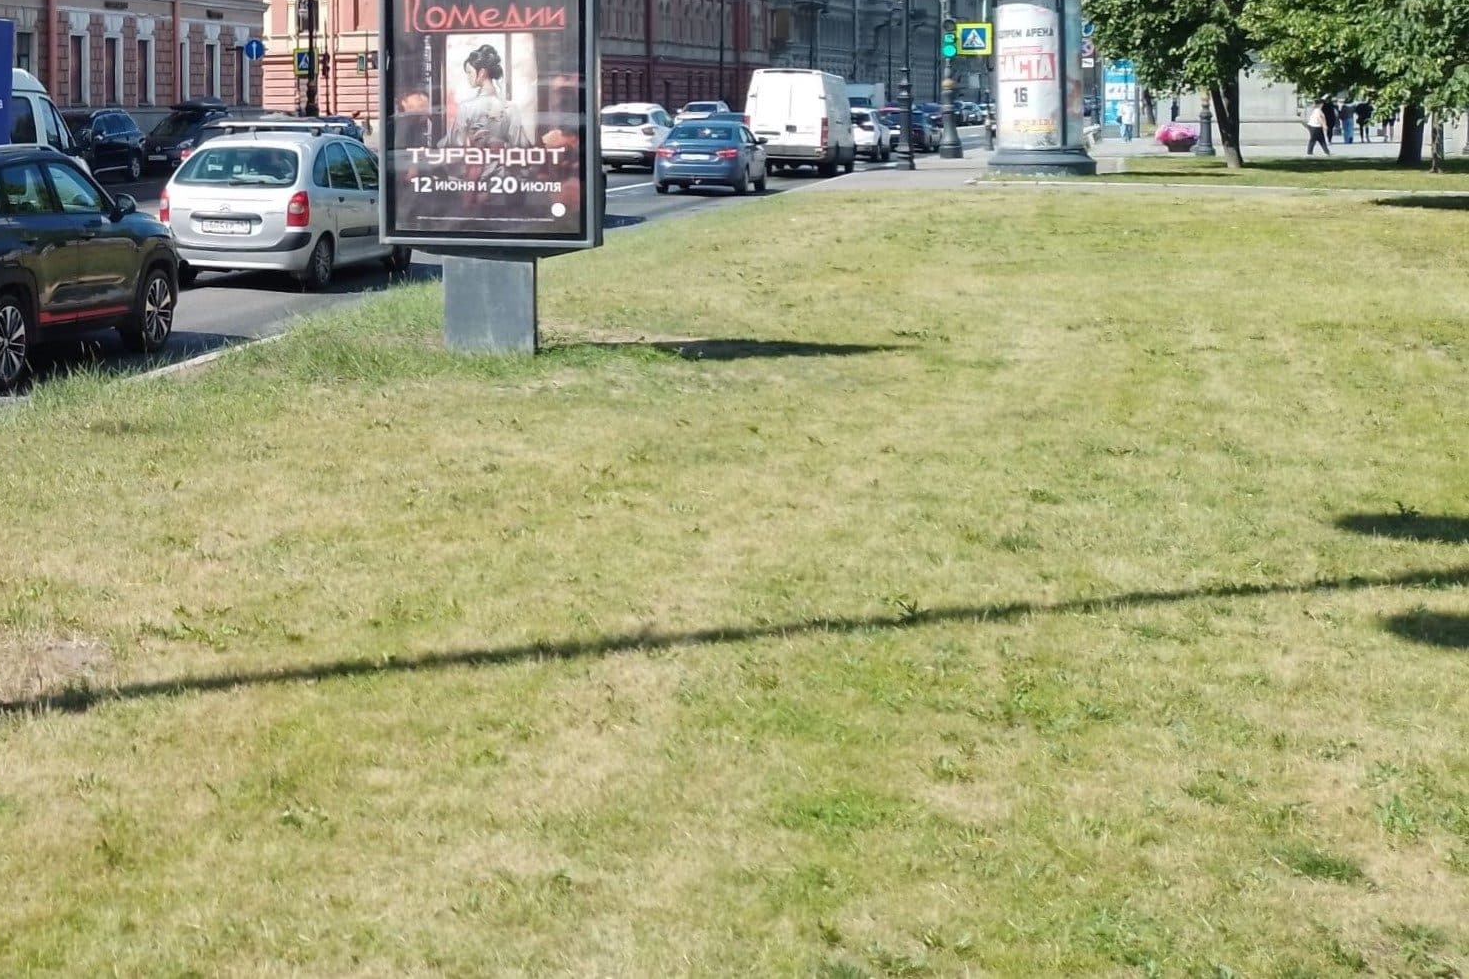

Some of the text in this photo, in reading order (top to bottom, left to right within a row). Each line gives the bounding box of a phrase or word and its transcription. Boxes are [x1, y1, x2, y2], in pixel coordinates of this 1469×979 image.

[1013, 87, 1029, 102] 16
[411, 176, 562, 193] 12 июня и 20 июля
